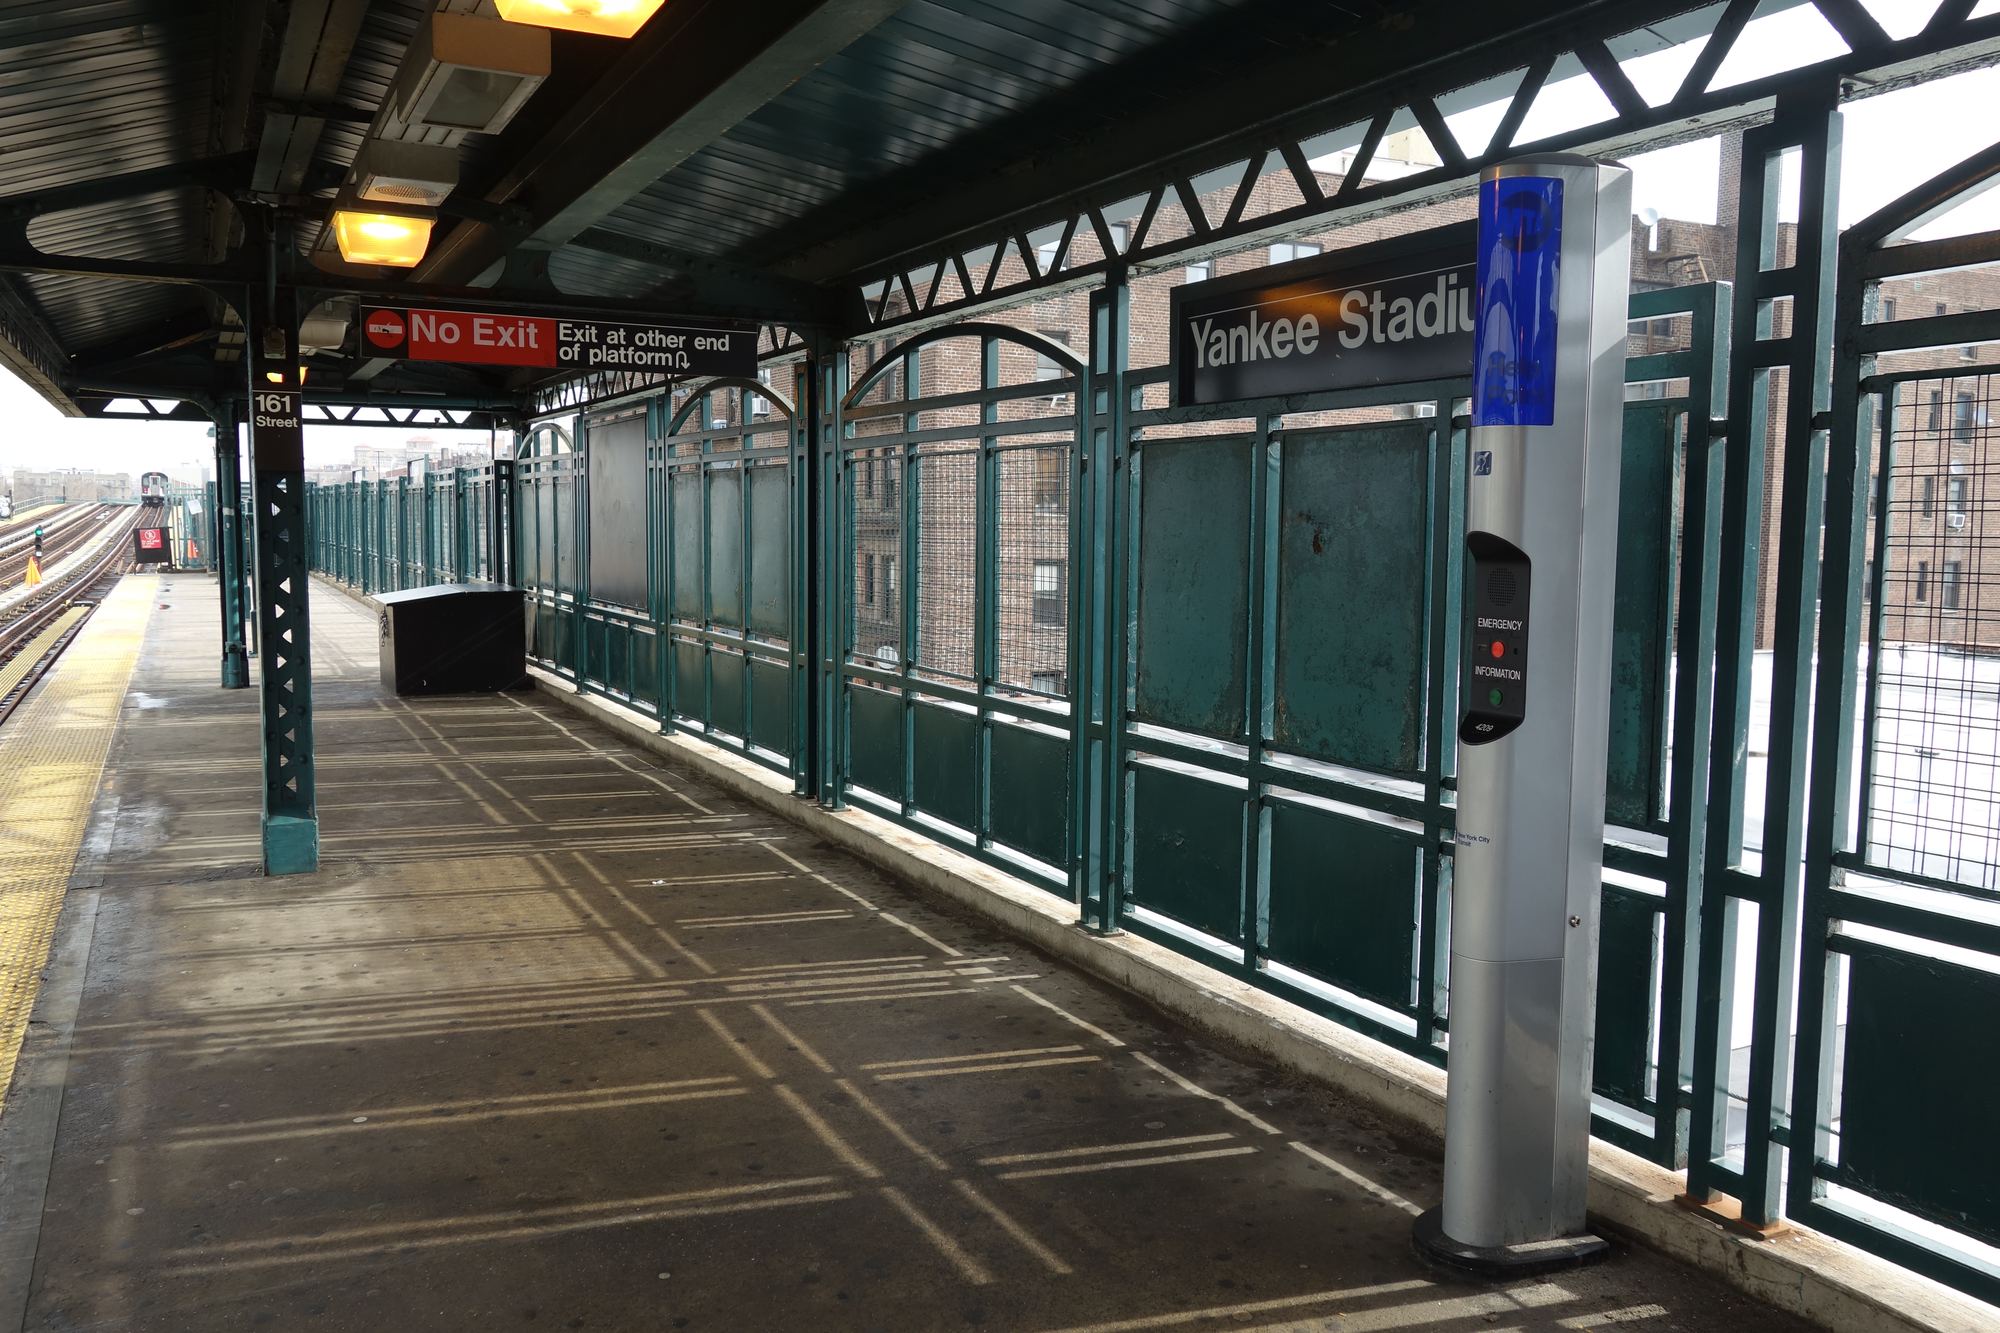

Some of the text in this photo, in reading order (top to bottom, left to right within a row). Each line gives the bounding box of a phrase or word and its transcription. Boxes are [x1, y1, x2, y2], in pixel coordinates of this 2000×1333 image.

[1191, 272, 1475, 369] Yankee Stadiu
[411, 313, 538, 350] No Exit
[559, 323, 730, 352] Exit at other end
[559, 343, 673, 366] of platform
[255, 394, 291, 413] 161
[256, 415, 298, 428] Street
[1477, 617, 1522, 631] EMERGENCY
[1474, 665, 1521, 680] INFORMATION
[1466, 833, 1478, 841] York
[1478, 835, 1490, 844] City
